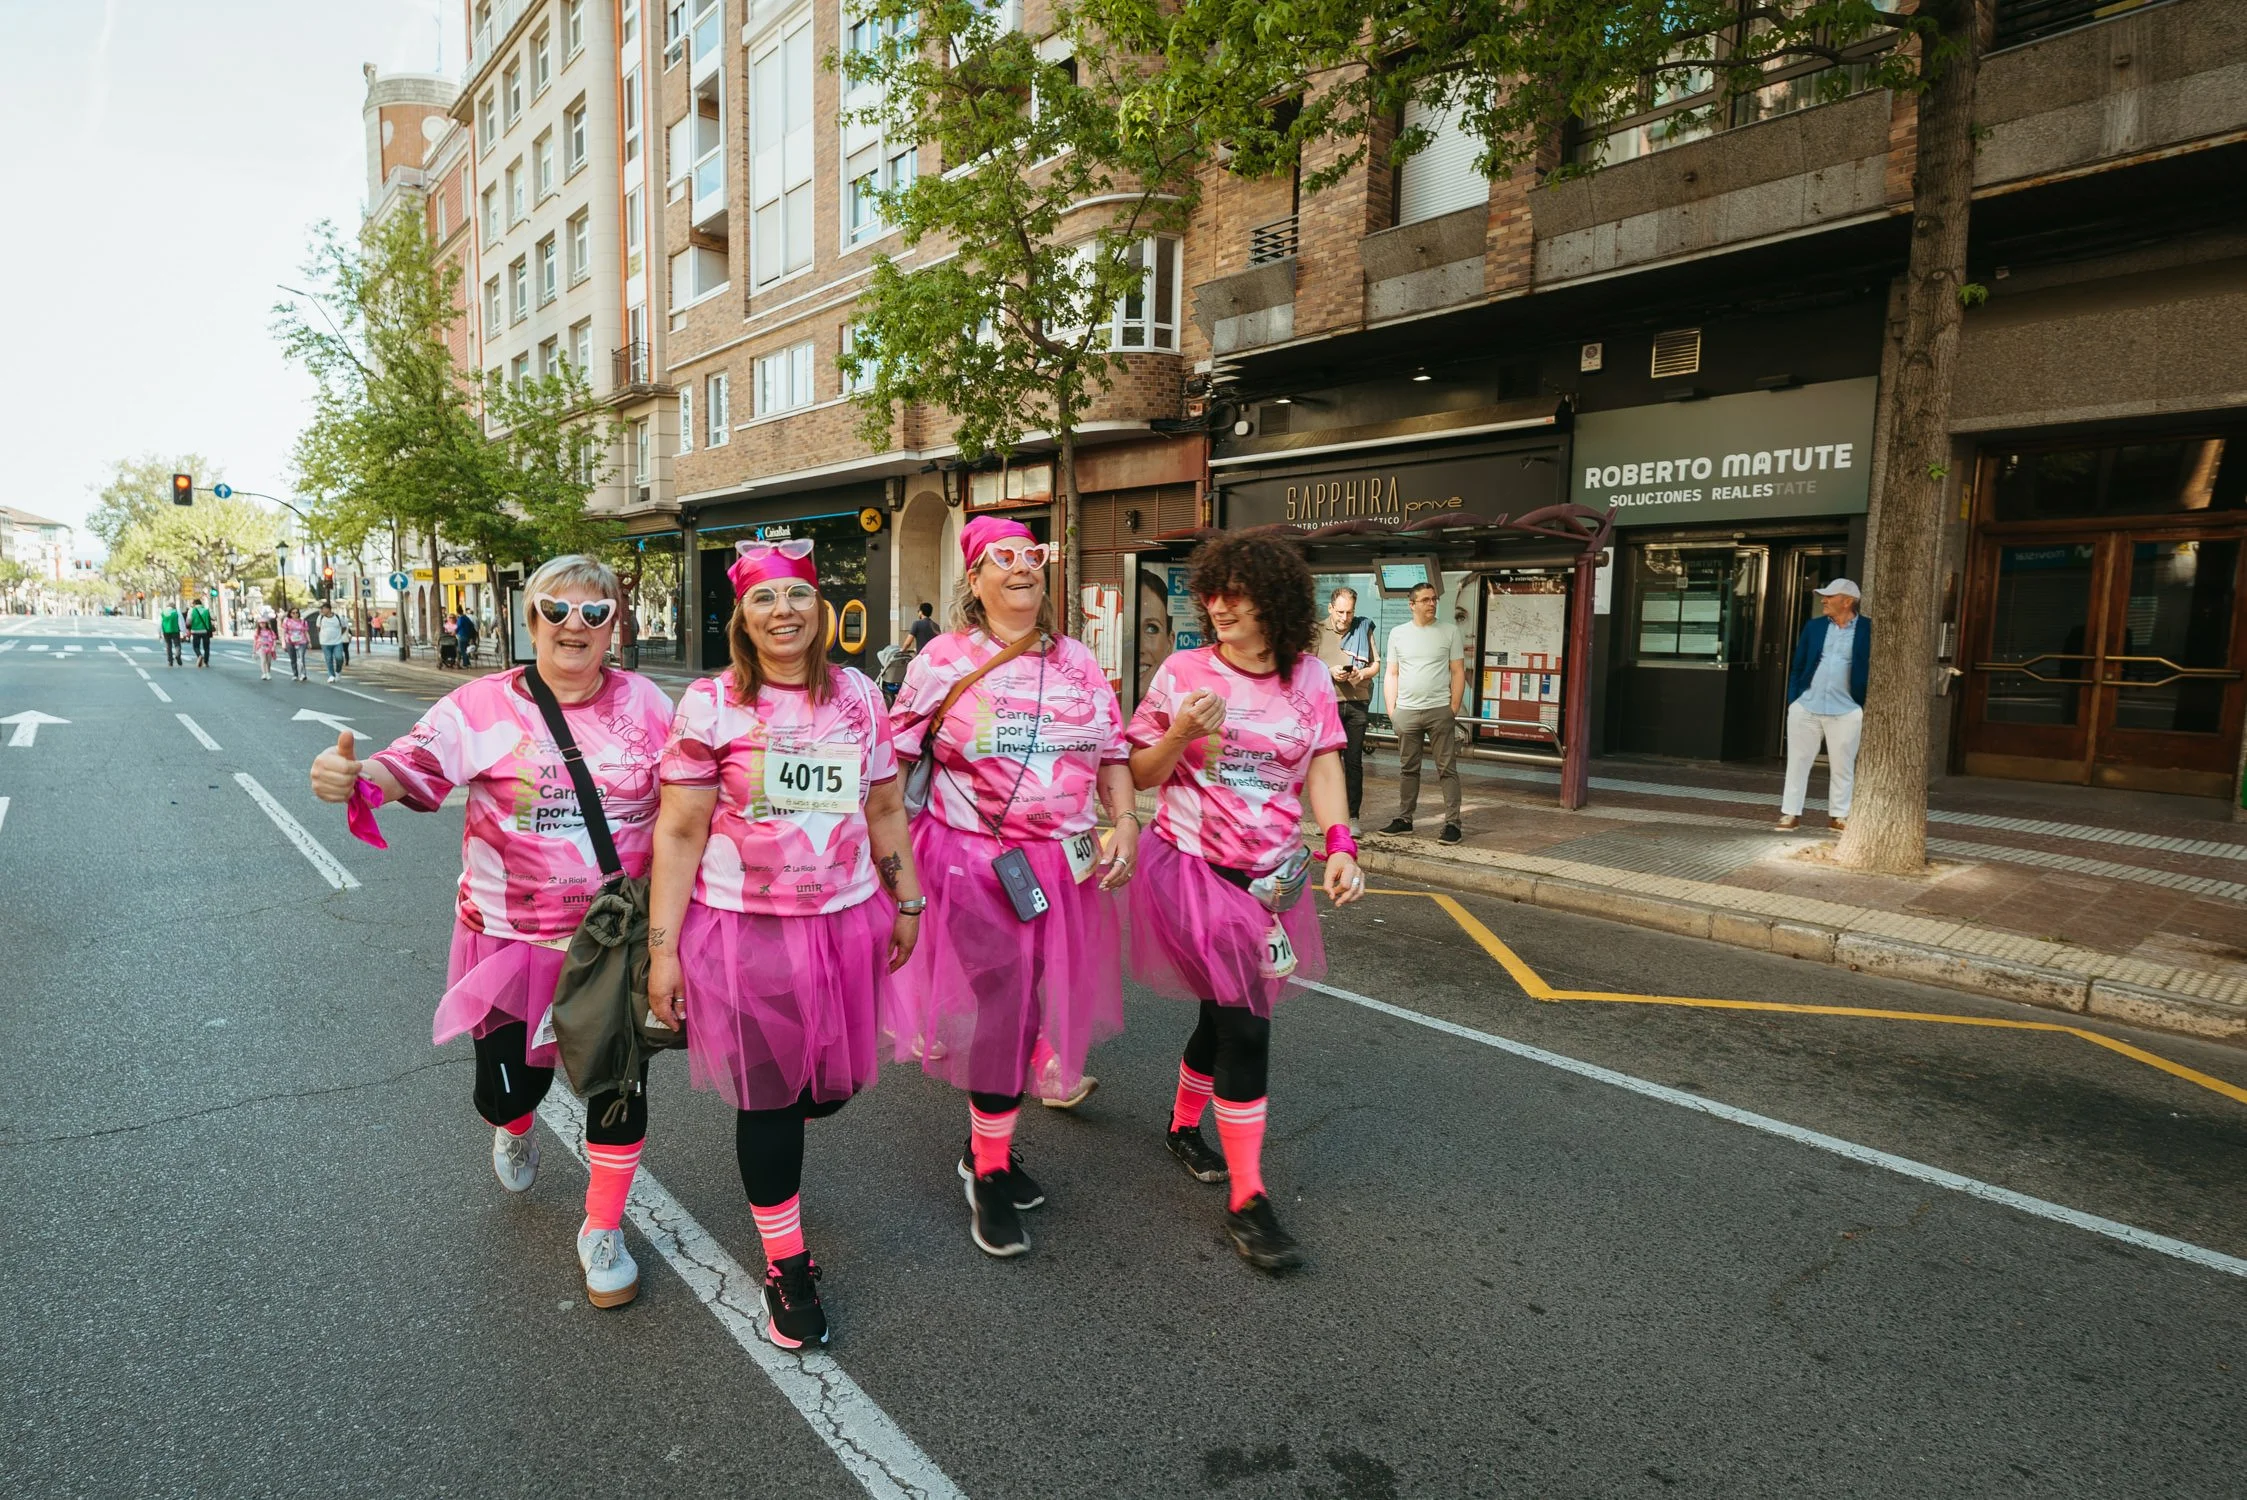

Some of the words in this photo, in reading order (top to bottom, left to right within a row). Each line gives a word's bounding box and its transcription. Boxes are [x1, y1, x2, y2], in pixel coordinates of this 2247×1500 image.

[1585, 456, 1712, 489] ROBERTO
[1721, 443, 1853, 478] MATUTE
[1286, 476, 1399, 520] SAPPHIRA
[1609, 488, 1702, 508] SOLUCIONES
[1711, 480, 1817, 500] REALESTATE
[764, 525, 792, 538] CaixaBank
[1289, 522, 1318, 530] NTRO
[995, 708, 1052, 723] Carrea
[997, 726, 1023, 739] por
[1222, 744, 1273, 760] Carrera
[539, 765, 557, 779] XI
[1219, 761, 1241, 774] por
[1243, 762, 1255, 773] la
[779, 762, 843, 793] 4015
[539, 784, 606, 800] Carra
[536, 806, 570, 820] por
[569, 875, 588, 884] Rioja
